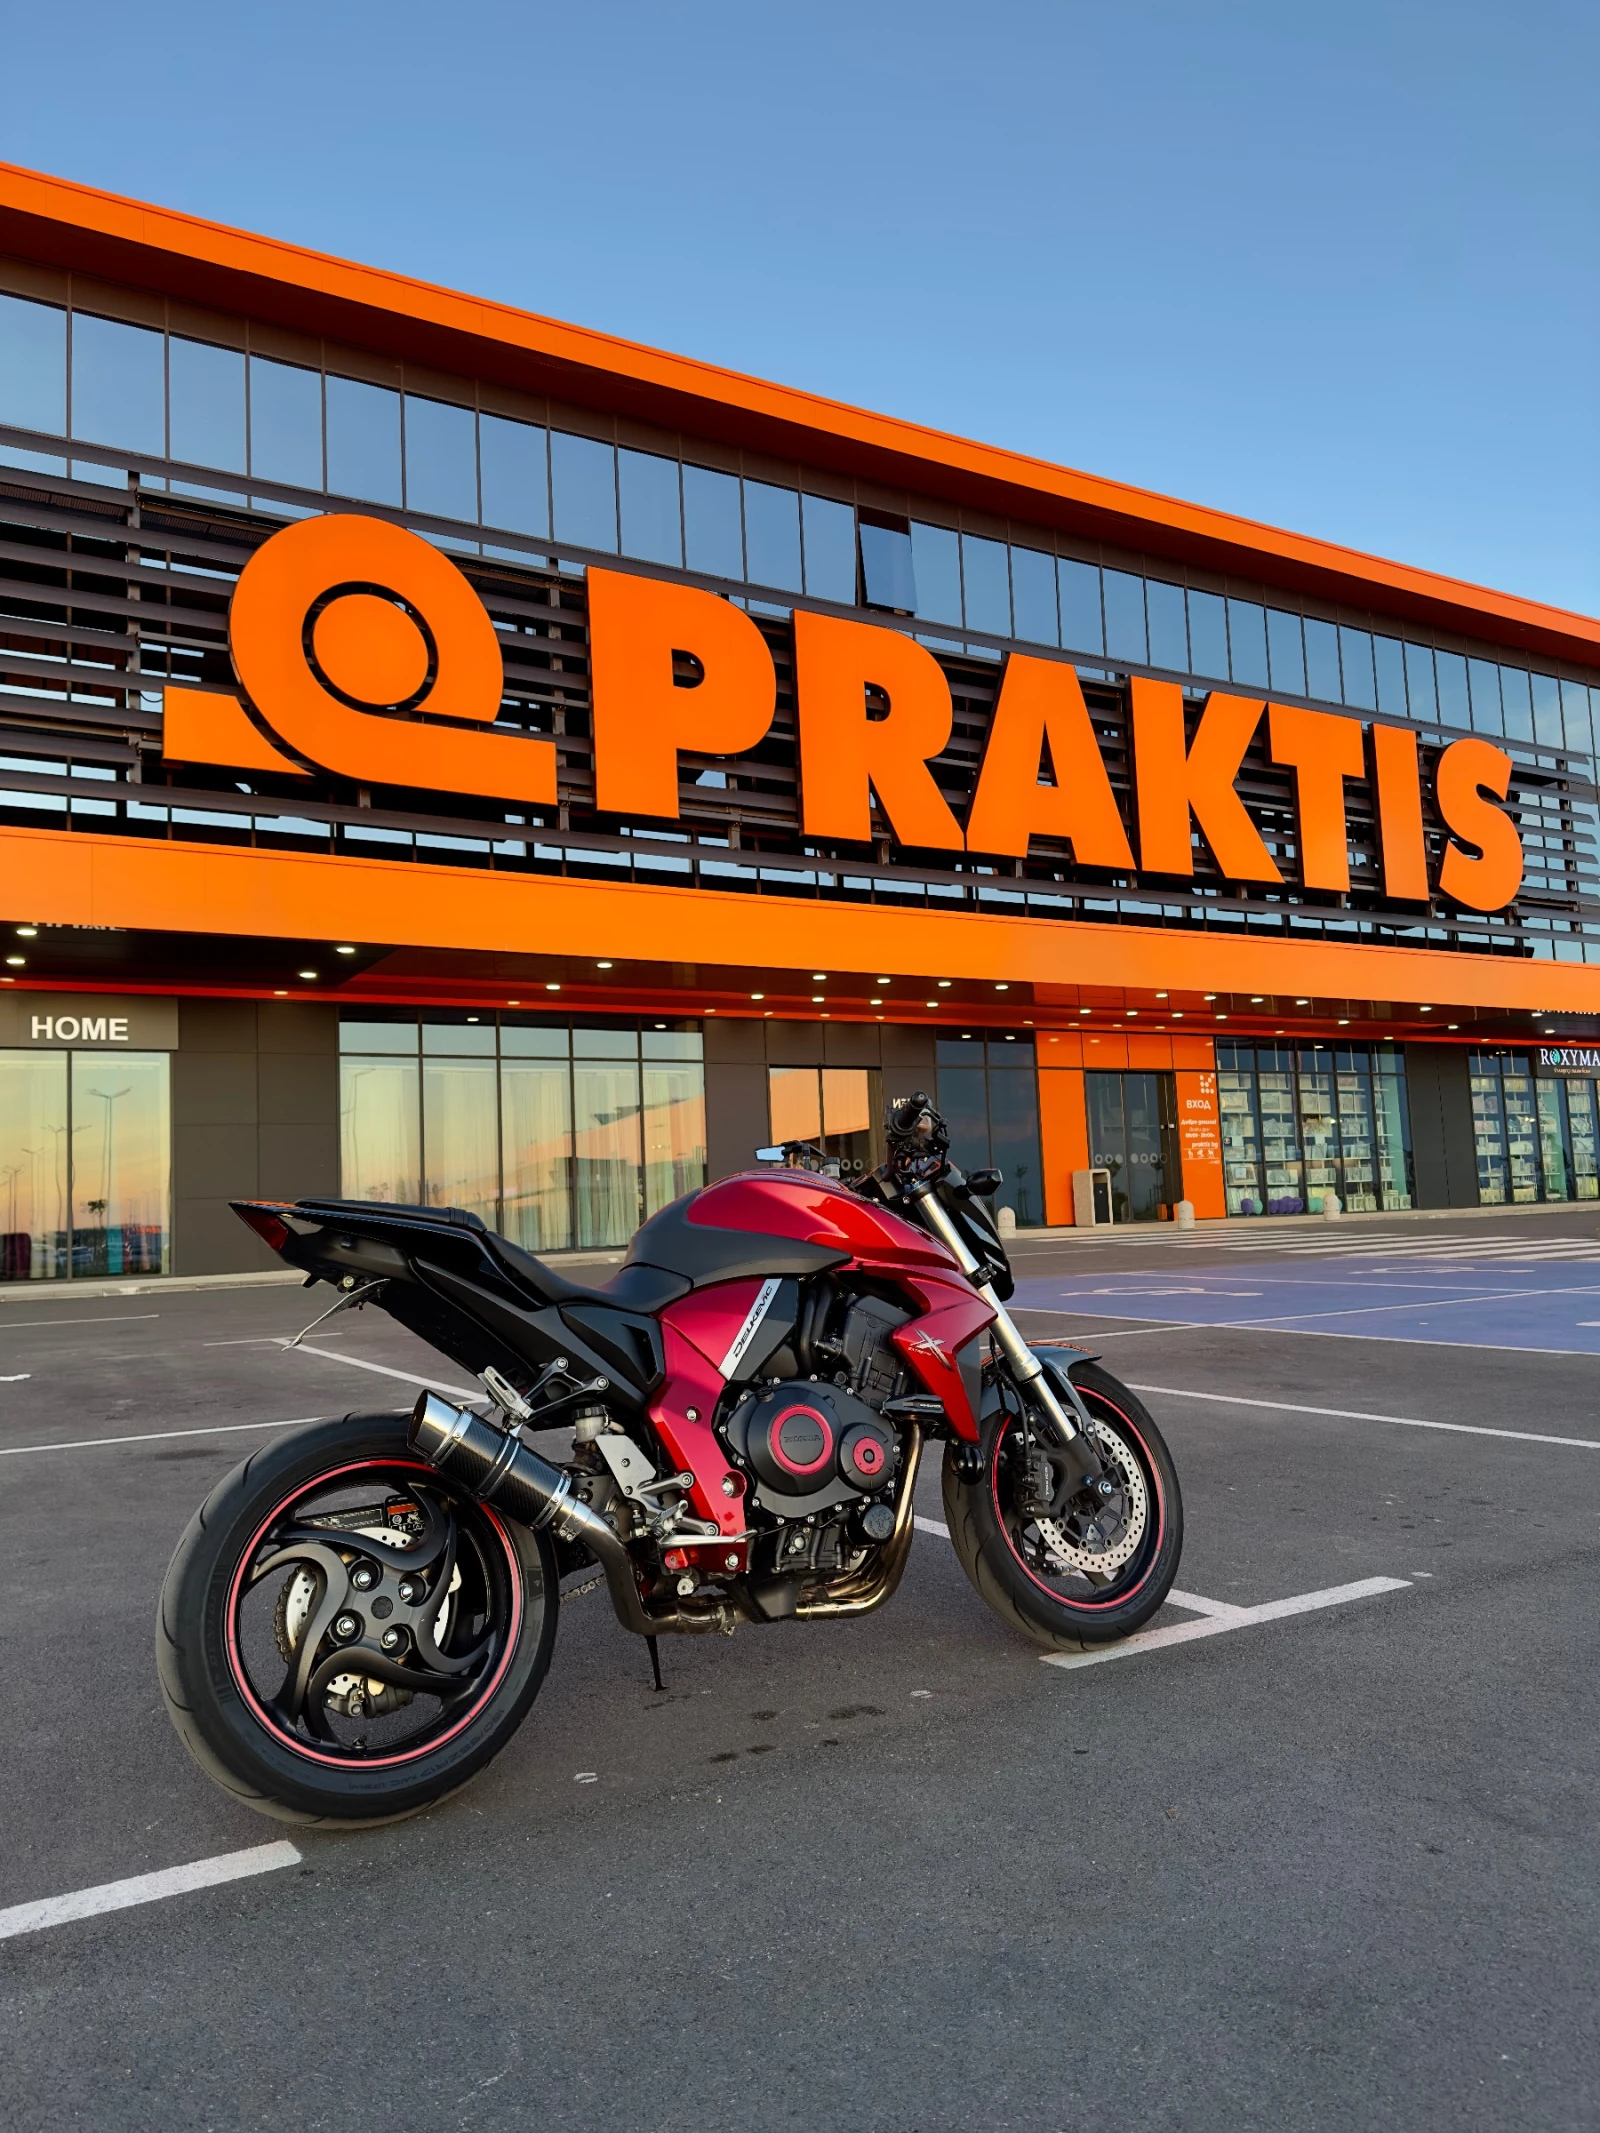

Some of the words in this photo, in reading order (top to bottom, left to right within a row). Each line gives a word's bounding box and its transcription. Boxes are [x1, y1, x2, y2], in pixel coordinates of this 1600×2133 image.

[584, 565, 1524, 912] PRAKTIS
[31, 1015, 129, 1041] HOME
[1186, 1099, 1211, 1110] ВХОД
[783, 1434, 822, 1443] HONDA
